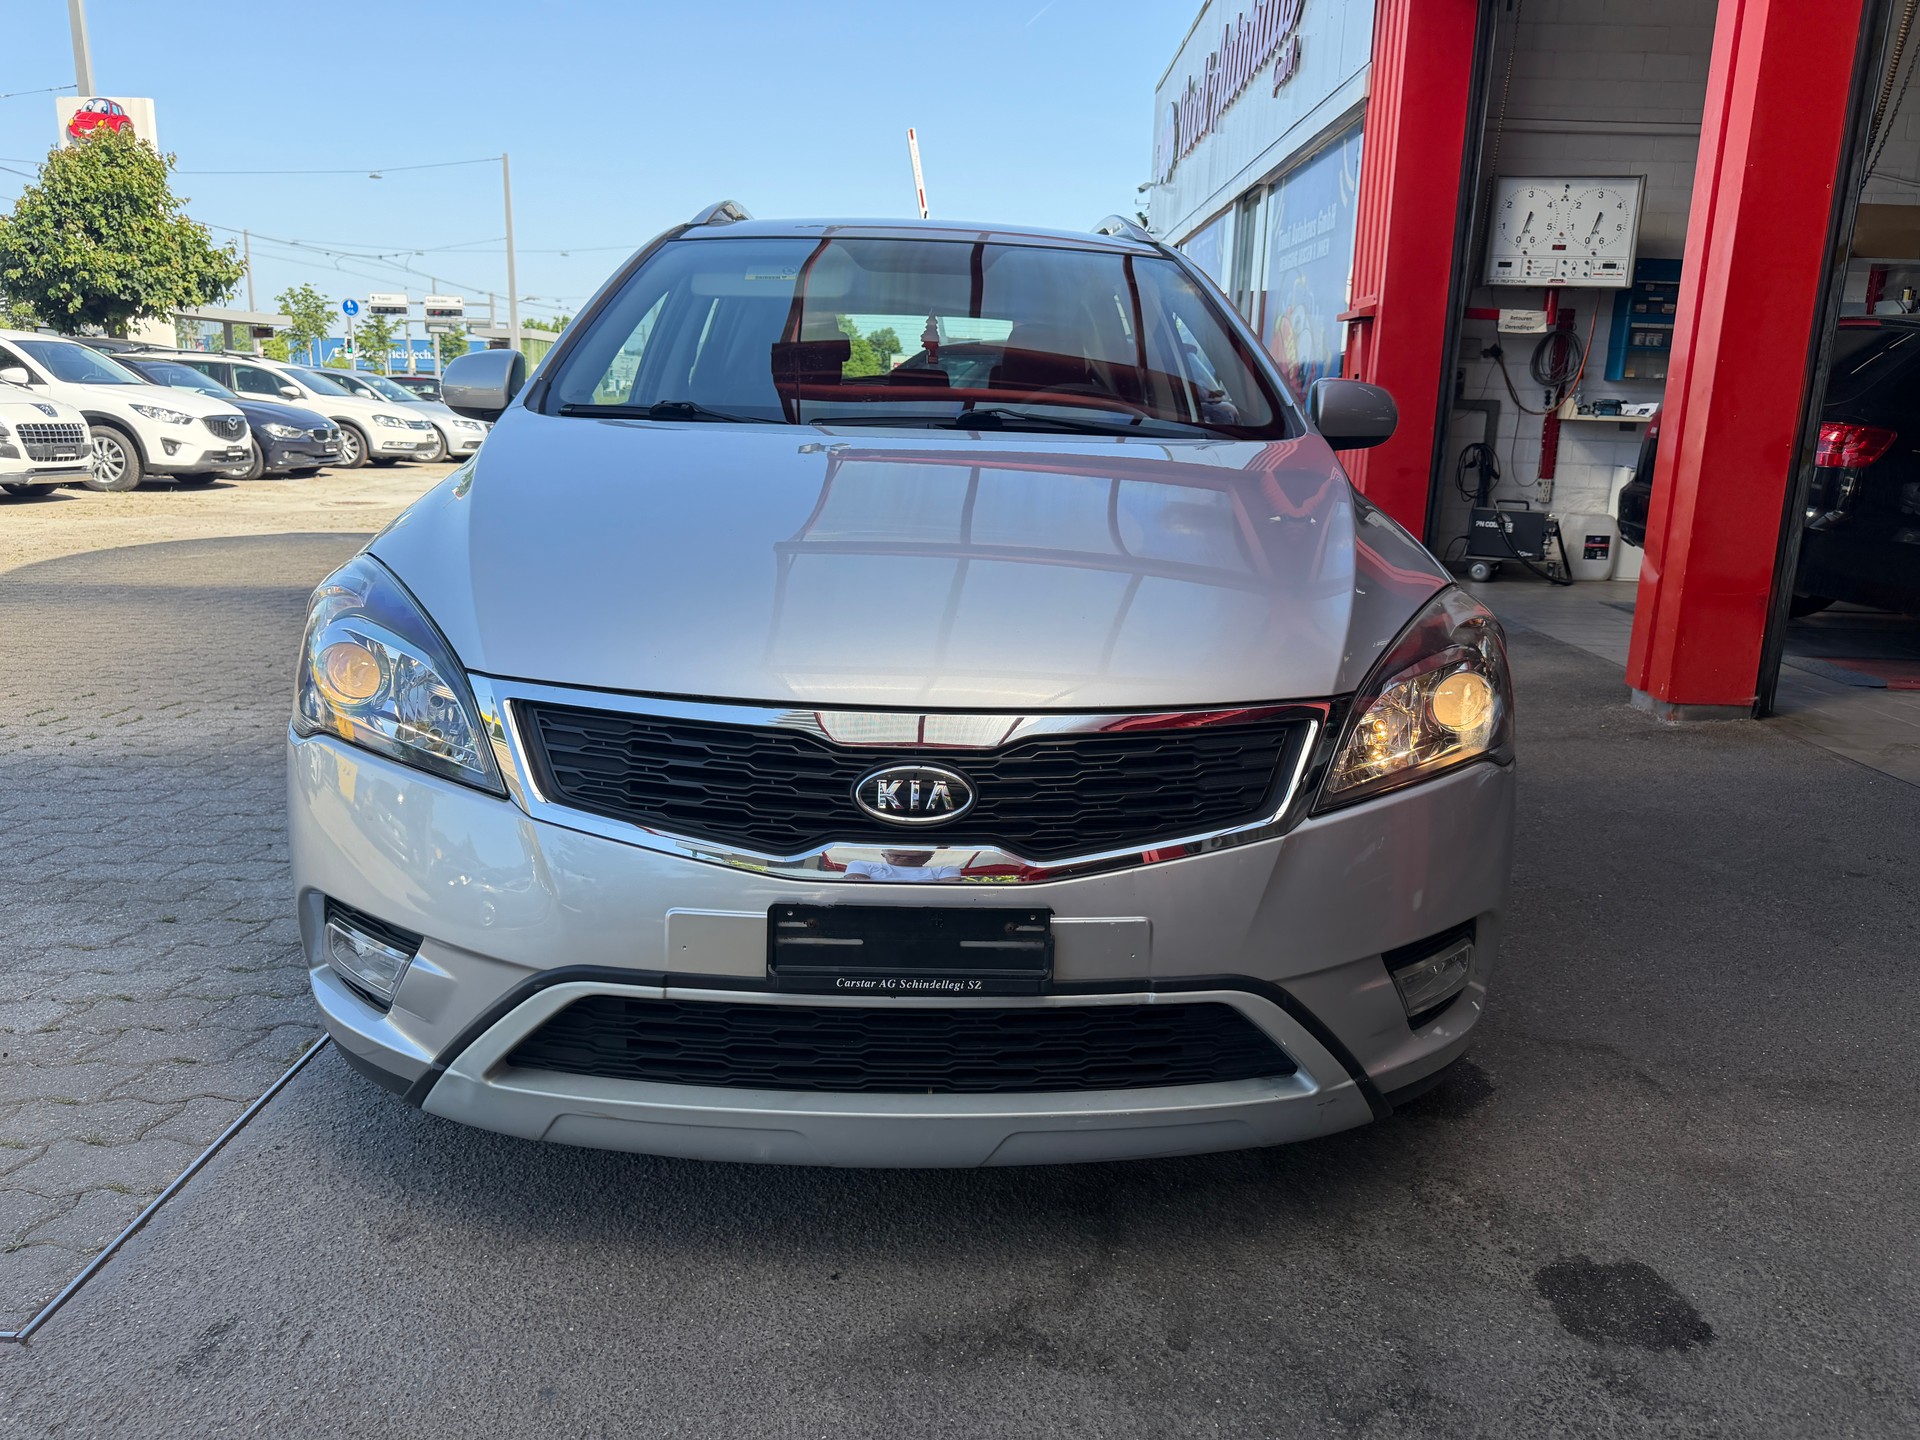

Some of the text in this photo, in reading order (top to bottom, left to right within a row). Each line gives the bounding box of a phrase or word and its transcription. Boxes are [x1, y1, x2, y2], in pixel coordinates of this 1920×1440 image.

[1528, 190, 1535, 198] 3
[1598, 190, 1604, 199] 3
[1506, 201, 1513, 209] 2
[1546, 201, 1553, 209] 4
[1575, 201, 1582, 209] 2
[1616, 202, 1623, 210] 4
[1502, 222, 1506, 230] 1
[1546, 222, 1553, 230] 5
[1570, 223, 1575, 231] 1
[1615, 223, 1622, 231] 5
[1515, 236, 1522, 244] 0
[1529, 236, 1536, 244] 6
[1584, 236, 1591, 245] 0
[1598, 237, 1605, 245] 6
[876, 780, 955, 811] KIA
[836, 978, 982, 992] Carstar AG Schindellegi SZ
